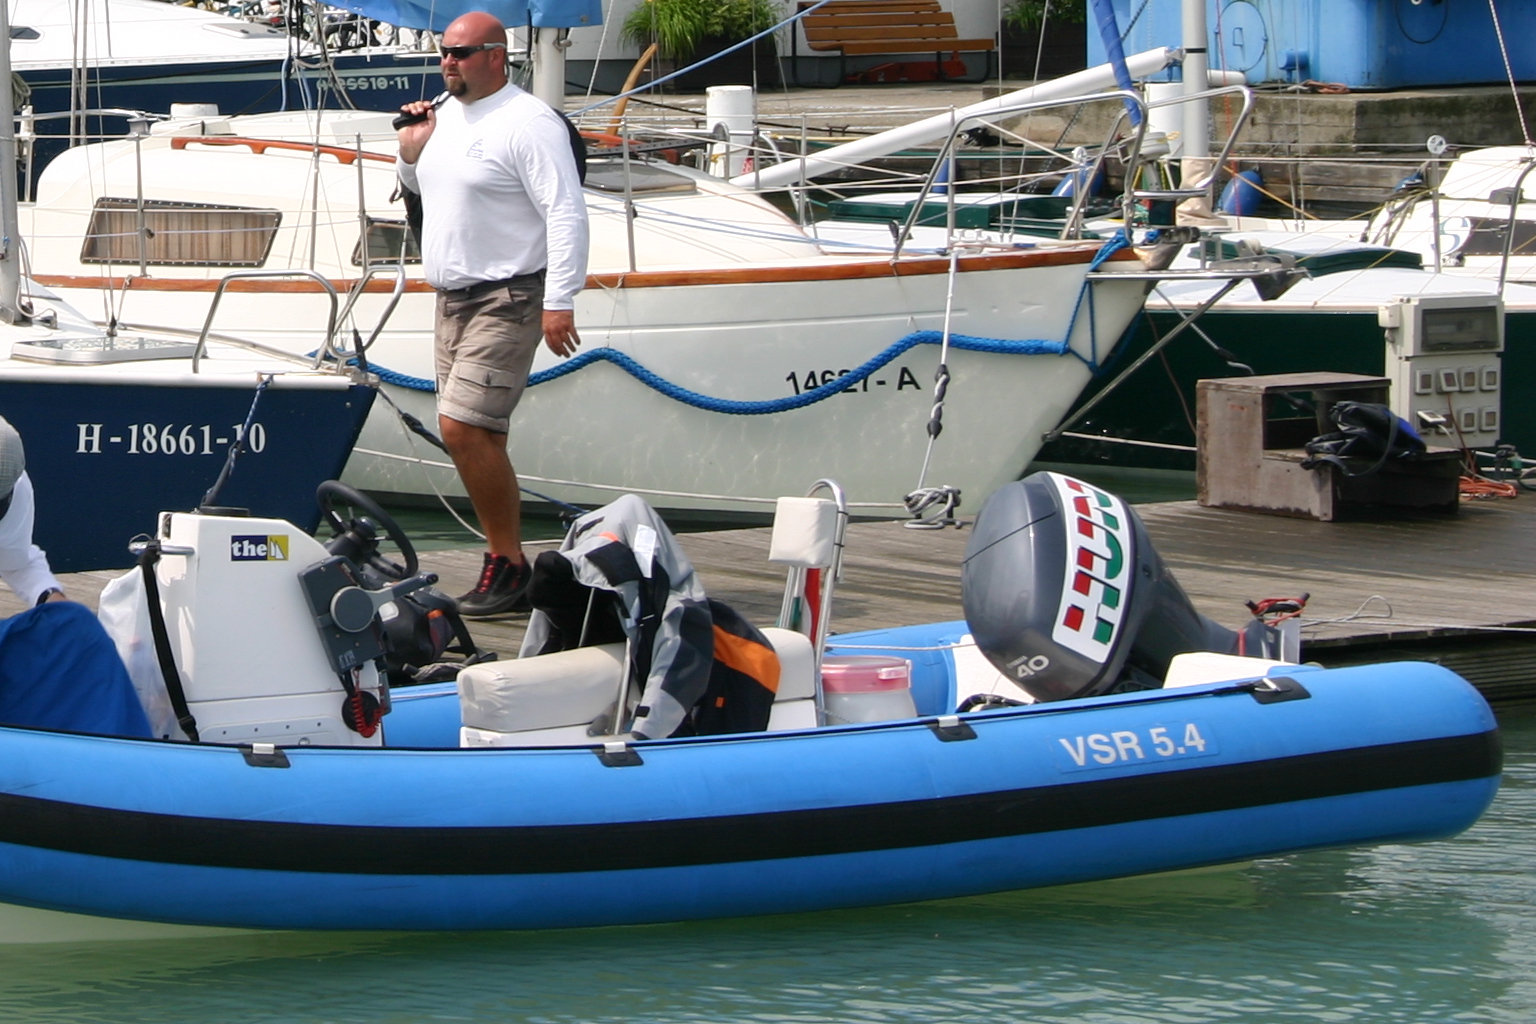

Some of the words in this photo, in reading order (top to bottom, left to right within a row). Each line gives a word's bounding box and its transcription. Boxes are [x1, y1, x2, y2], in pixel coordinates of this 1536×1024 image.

[231, 539, 267, 557] the
[1017, 655, 1050, 678] 40
[1058, 731, 1145, 766] VSR
[1149, 723, 1206, 757] 5.4
